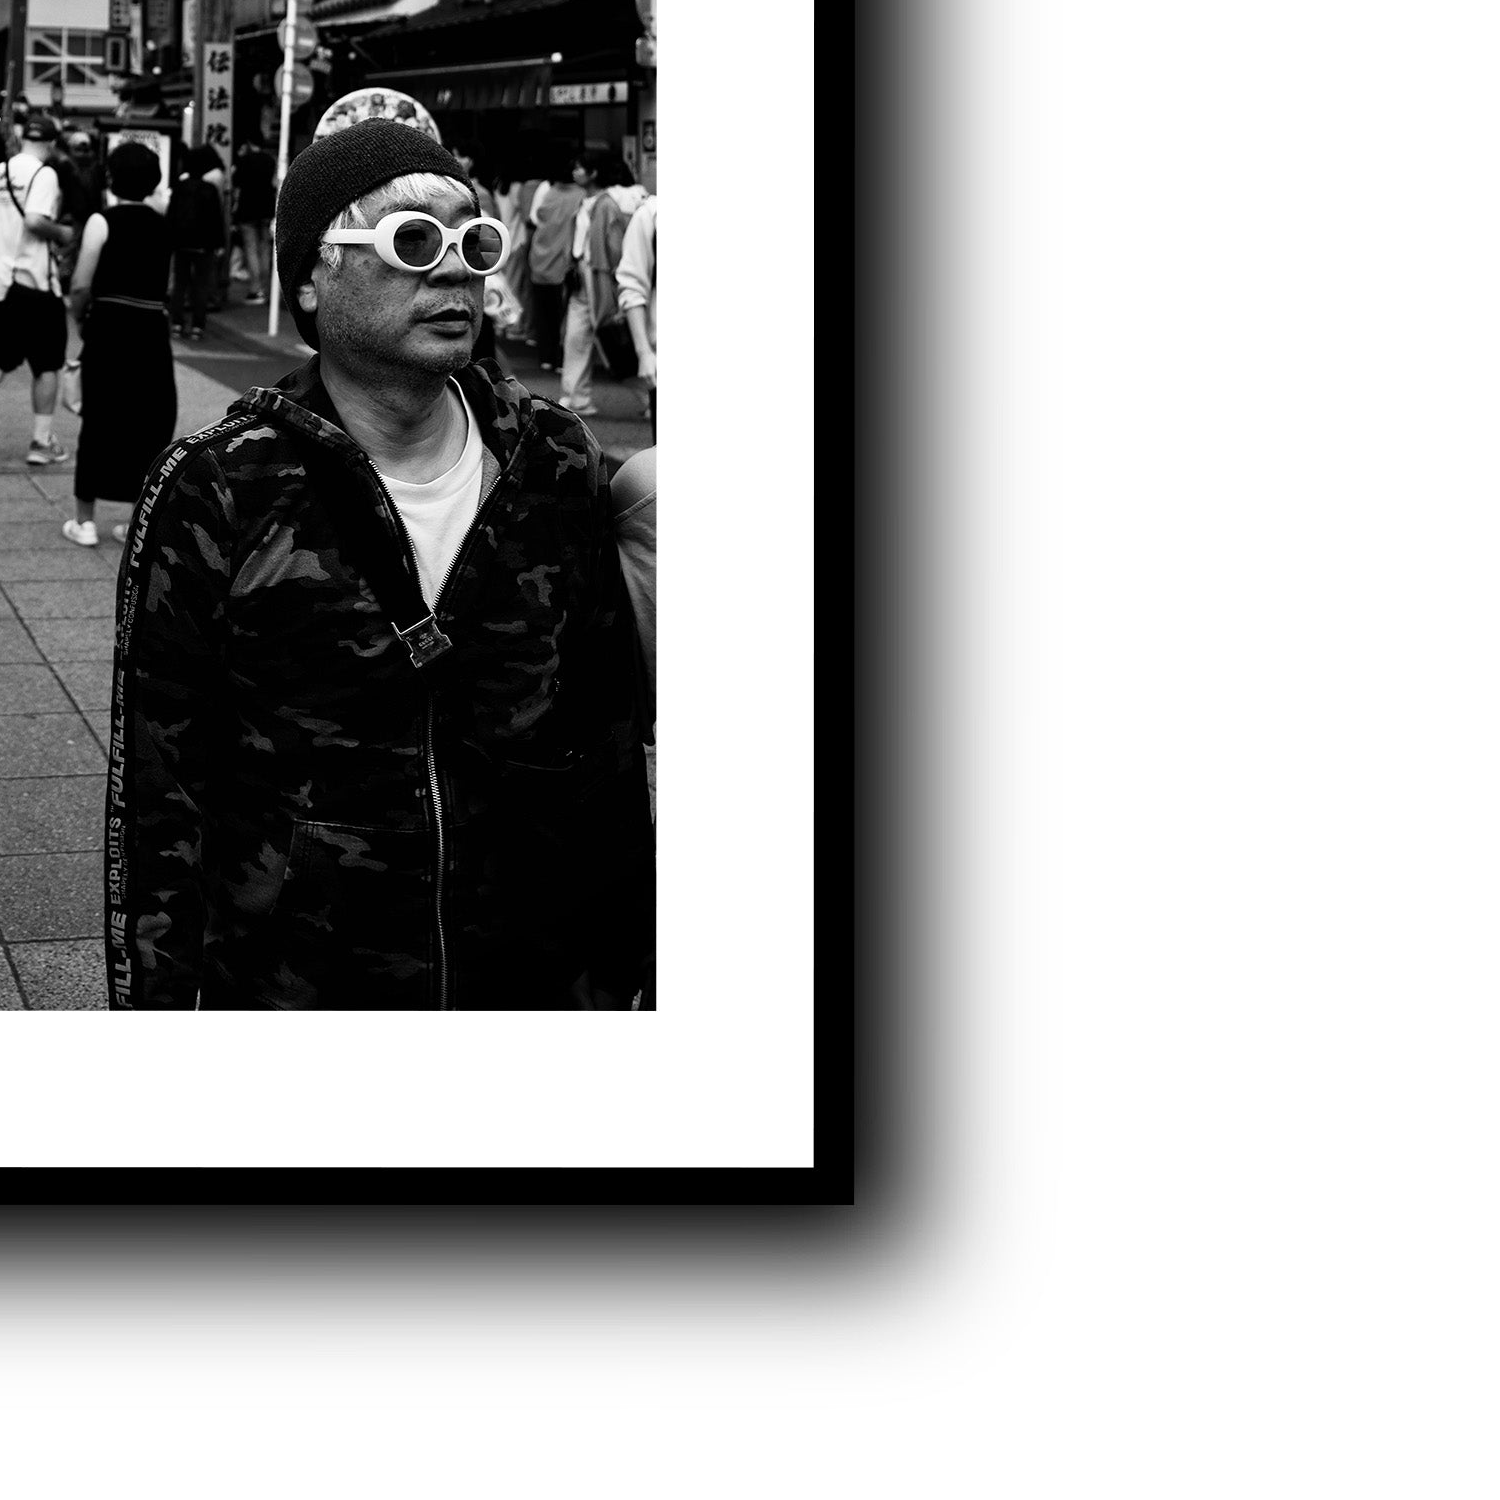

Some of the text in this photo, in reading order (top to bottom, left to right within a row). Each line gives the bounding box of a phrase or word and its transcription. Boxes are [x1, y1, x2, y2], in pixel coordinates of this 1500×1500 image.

[206, 49, 231, 148] 伝法院
[129, 446, 188, 568] FULFILL-ME
[109, 816, 122, 905] EXPLOITS
